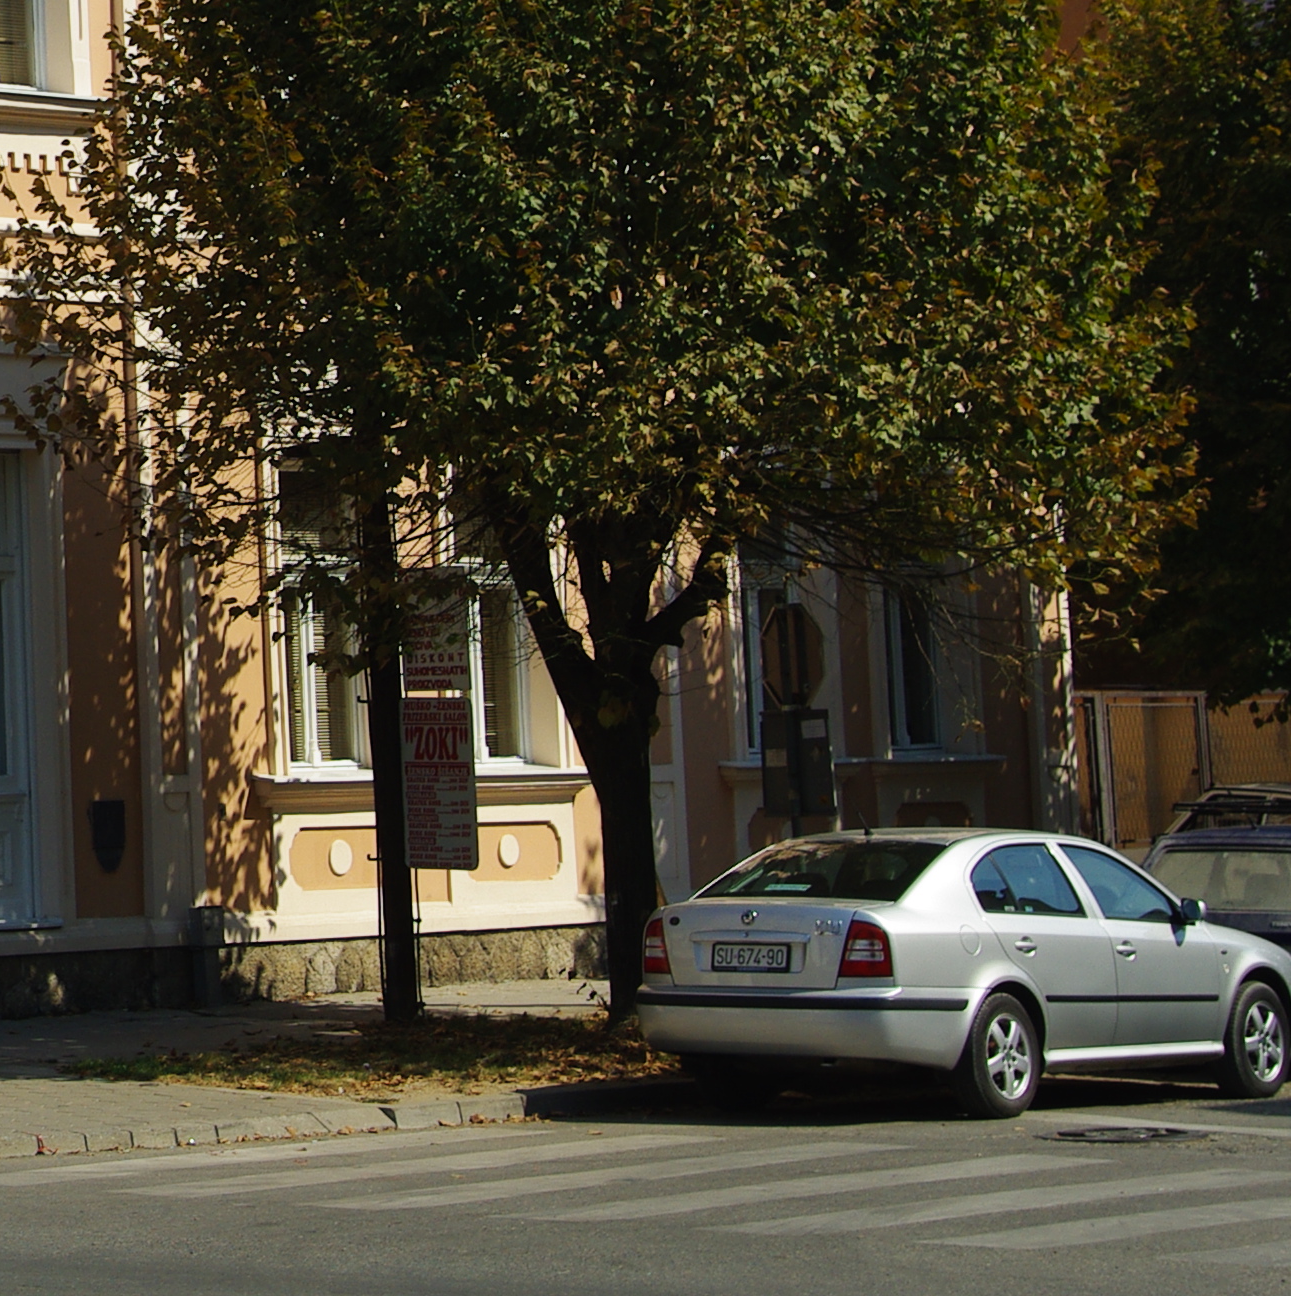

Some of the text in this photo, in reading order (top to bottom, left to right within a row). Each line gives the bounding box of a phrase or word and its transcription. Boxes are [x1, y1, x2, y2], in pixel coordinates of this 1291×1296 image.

[406, 652, 464, 664] DISKONT
[406, 679, 454, 689] PROIZVODA
[403, 712, 468, 722] FRIZERSKI SALON
[405, 726, 468, 761] "ZOKI"
[737, 948, 784, 965] 674-90
